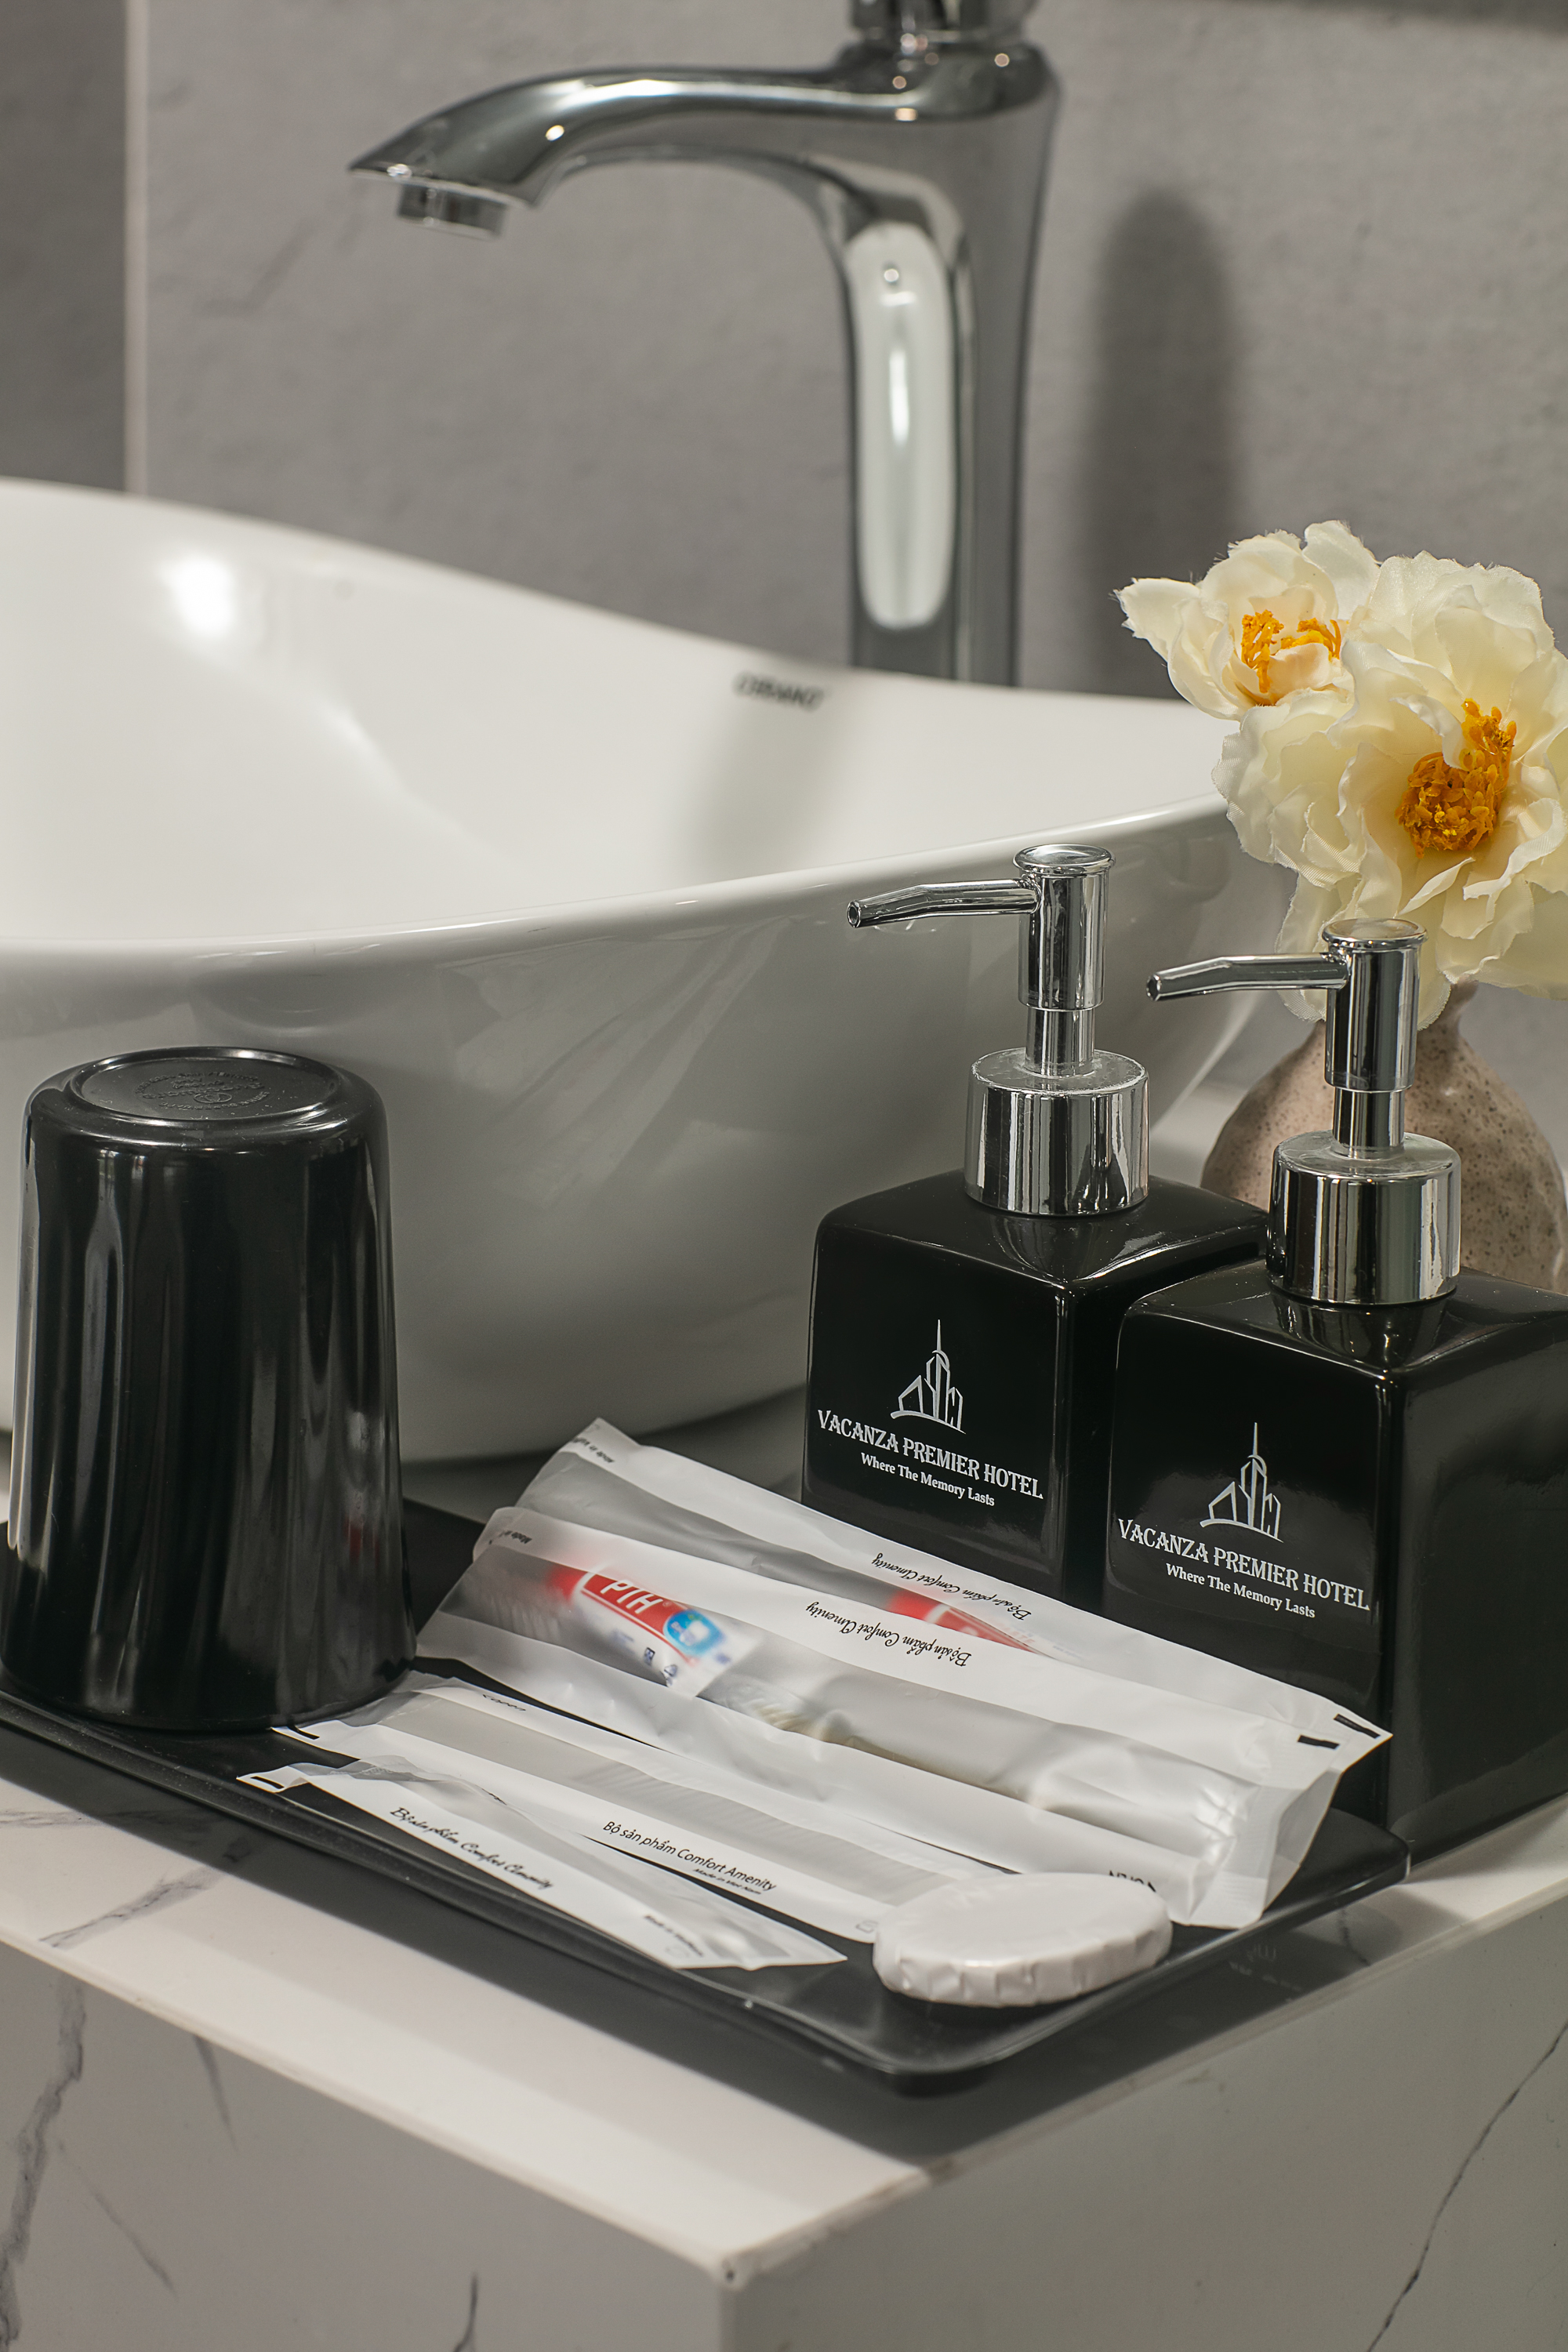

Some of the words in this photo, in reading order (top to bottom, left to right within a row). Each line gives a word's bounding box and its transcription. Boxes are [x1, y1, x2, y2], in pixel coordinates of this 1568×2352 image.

[818, 1410, 899, 1453] VACANZA
[902, 1437, 980, 1480] PREMIER
[984, 1464, 1044, 1499] HOTEL
[861, 1452, 896, 1475] Where
[898, 1465, 919, 1482] The
[920, 1472, 966, 1499] Memory
[967, 1486, 995, 1507] Lasts
[871, 1552, 918, 1581] Amenity
[1118, 1519, 1209, 1563] VACANZA
[1214, 1547, 1299, 1591] PREMIER
[1304, 1573, 1370, 1611] HOTEL
[917, 1574, 960, 1594] Comfort
[1166, 1563, 1205, 1585] Where
[1207, 1574, 1231, 1592] The
[1233, 1582, 1283, 1611] Memory
[1285, 1599, 1316, 1618] Lasts
[804, 1601, 857, 1635] Amenity
[856, 1622, 900, 1647] Comfort
[902, 1636, 934, 1656] phẩm
[934, 1645, 953, 1660] sản
[950, 1646, 972, 1668] Bộ
[602, 1820, 622, 1835] Bộ
[619, 1829, 641, 1842] sản
[638, 1837, 677, 1855] phẩm
[677, 1849, 726, 1873] Comfort
[724, 1867, 777, 1892] Amenity
